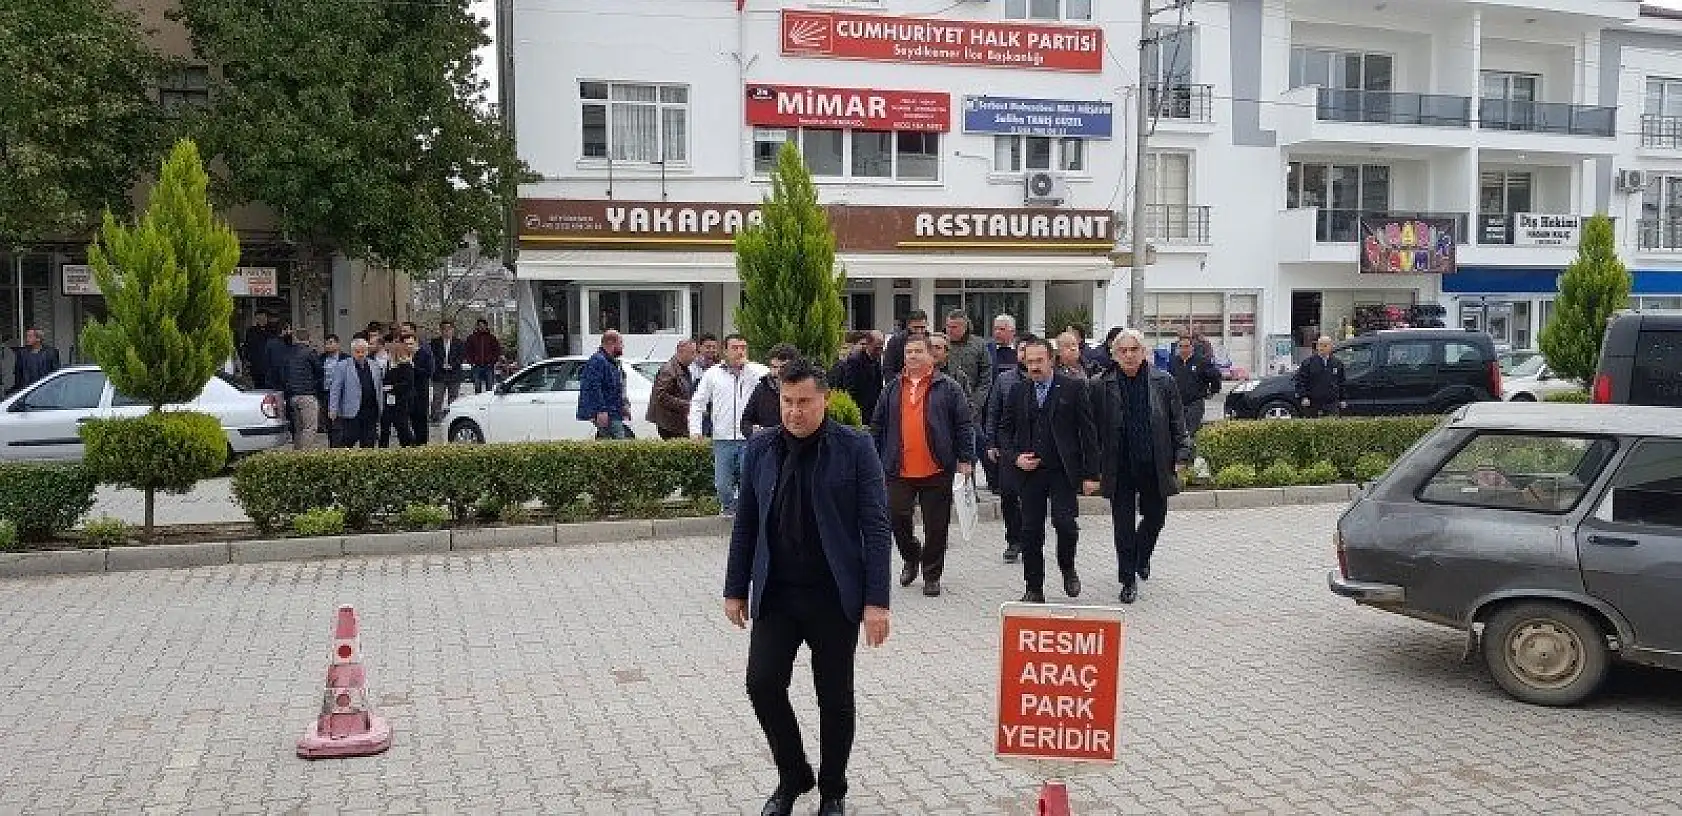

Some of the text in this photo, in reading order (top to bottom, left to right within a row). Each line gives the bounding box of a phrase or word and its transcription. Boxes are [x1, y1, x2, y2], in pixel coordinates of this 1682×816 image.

[837, 21, 1096, 51] CUMHURİYET HALK PARTİSİ
[777, 89, 886, 118] MİMAR
[916, 212, 1111, 238] RESTAURANT
[1018, 628, 1105, 655] RESMİ
[1019, 662, 1099, 692] ARAÇ
[1021, 693, 1094, 719] PARK
[1002, 721, 1111, 752] YERİDİR
